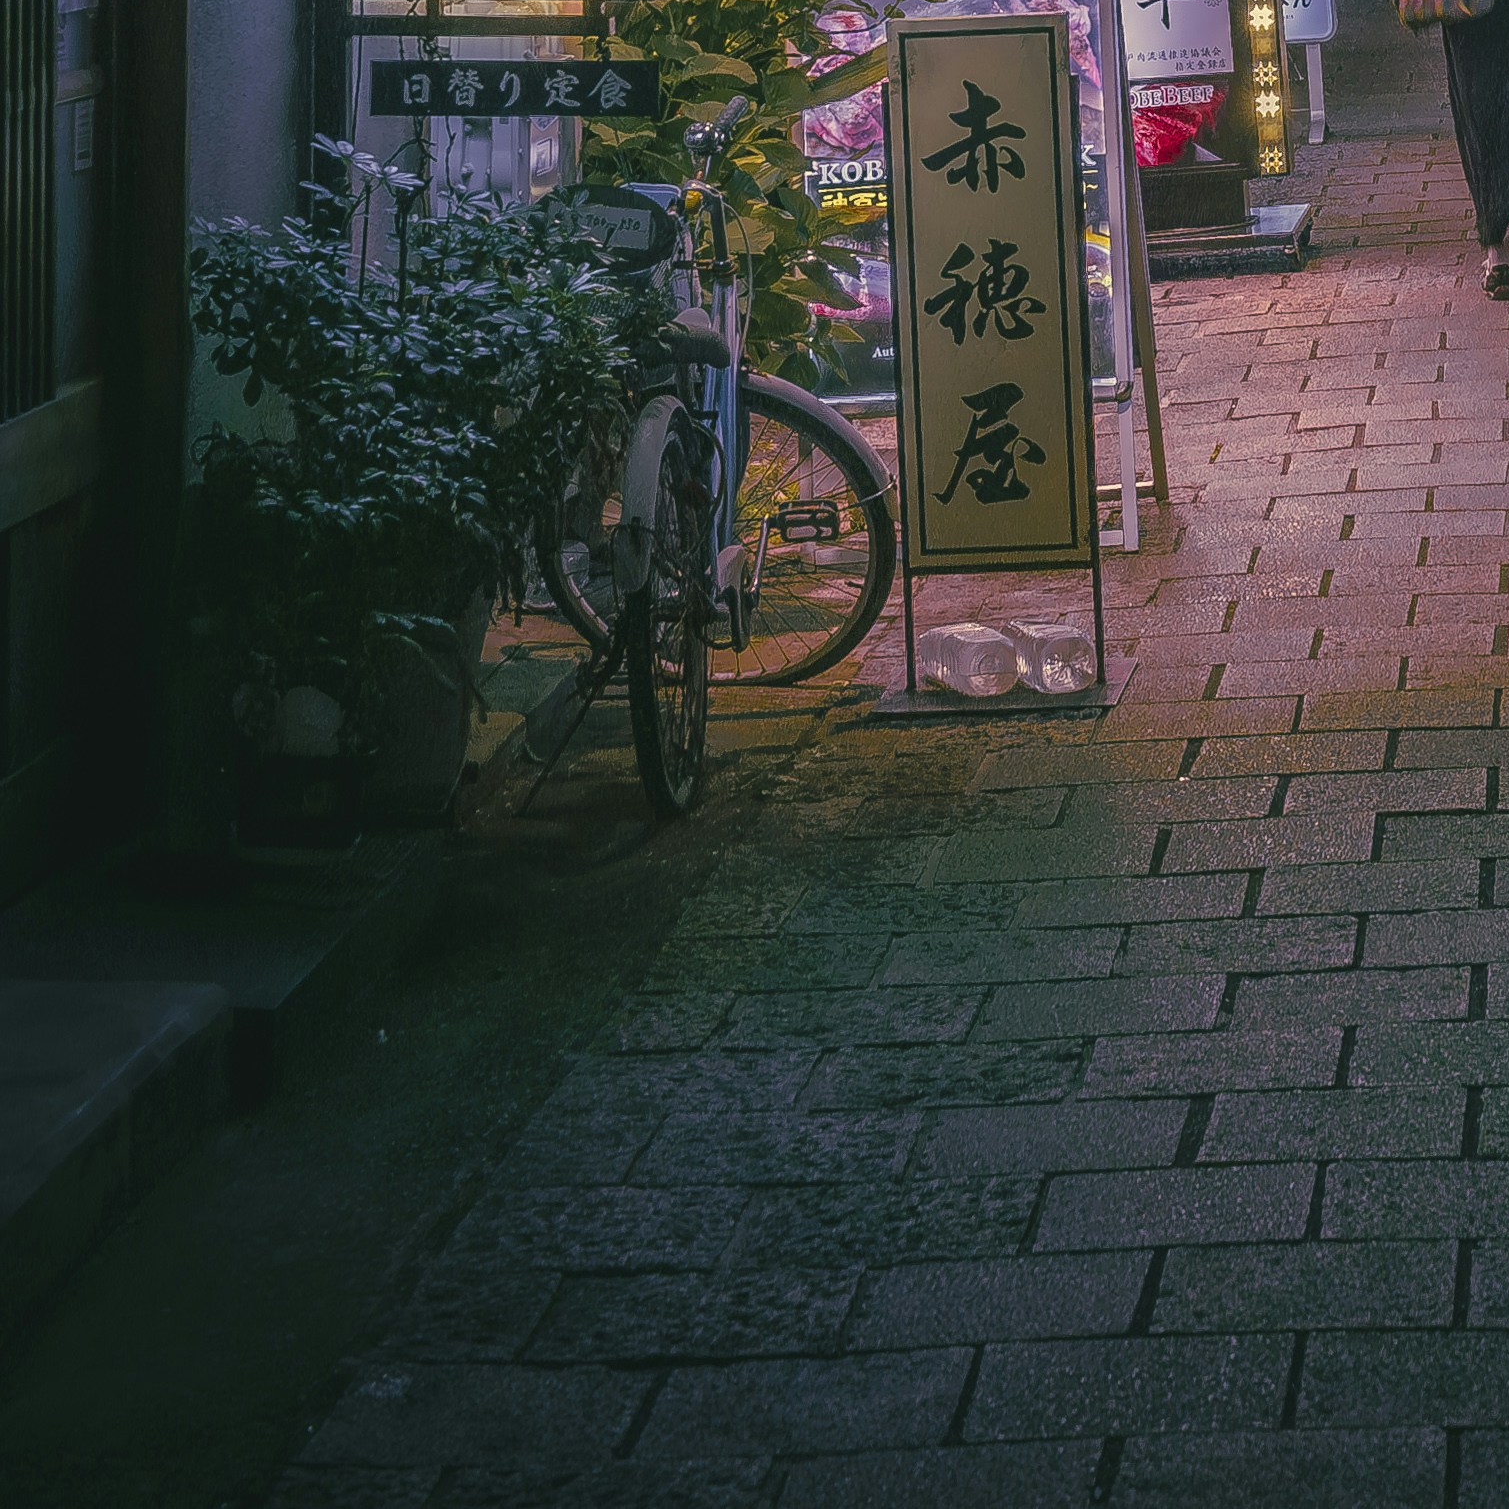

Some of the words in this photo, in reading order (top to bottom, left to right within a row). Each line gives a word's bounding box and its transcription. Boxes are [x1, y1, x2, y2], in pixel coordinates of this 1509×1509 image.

[403, 68, 633, 109] 日替り定食
[1130, 90, 1162, 109] OBE
[1162, 85, 1214, 105] BEEF
[818, 159, 887, 185] KOB
[920, 80, 1047, 506] 赤穂屋
[872, 346, 896, 359] Aut
